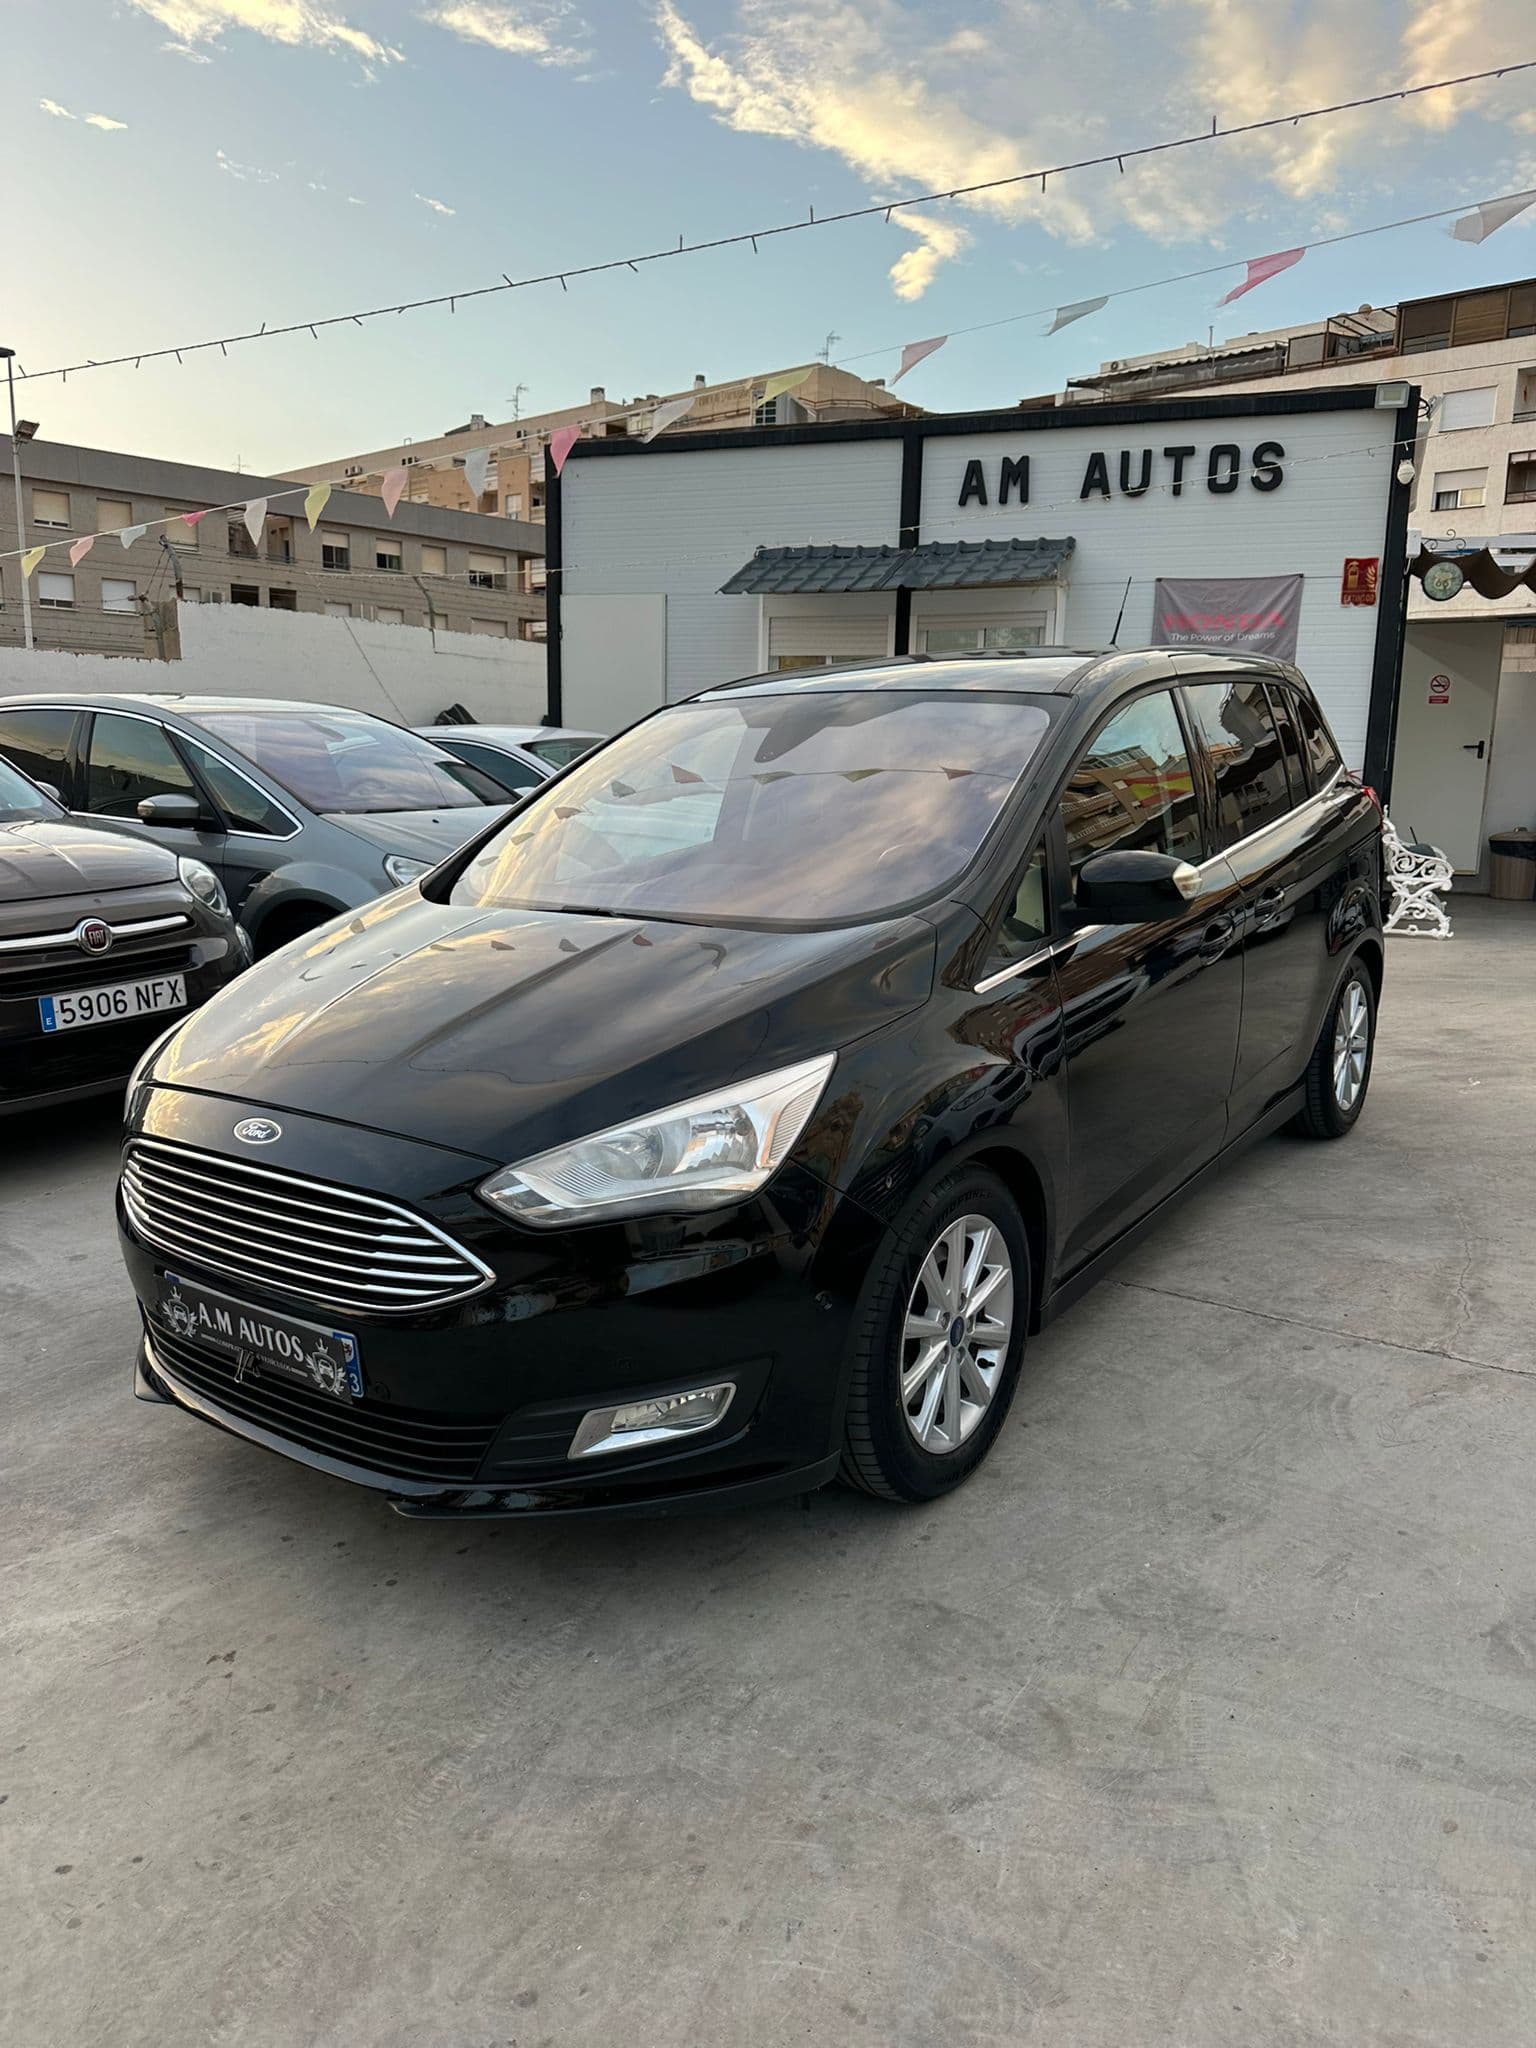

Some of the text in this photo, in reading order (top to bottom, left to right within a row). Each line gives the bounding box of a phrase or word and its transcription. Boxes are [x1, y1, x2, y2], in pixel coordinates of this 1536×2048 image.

[958, 441, 1286, 507] AM AUTOS
[1163, 611, 1286, 631] HONDA
[1171, 631, 1276, 642] The Power of Dreams
[88, 929, 105, 946] FIAT
[59, 978, 183, 1025] 5906 NFX
[45, 1017, 53, 1026] E
[242, 1121, 272, 1139] Ford
[198, 1302, 233, 1337] A.M
[239, 1315, 305, 1363] AUTOS
[350, 1373, 360, 1393] 3
